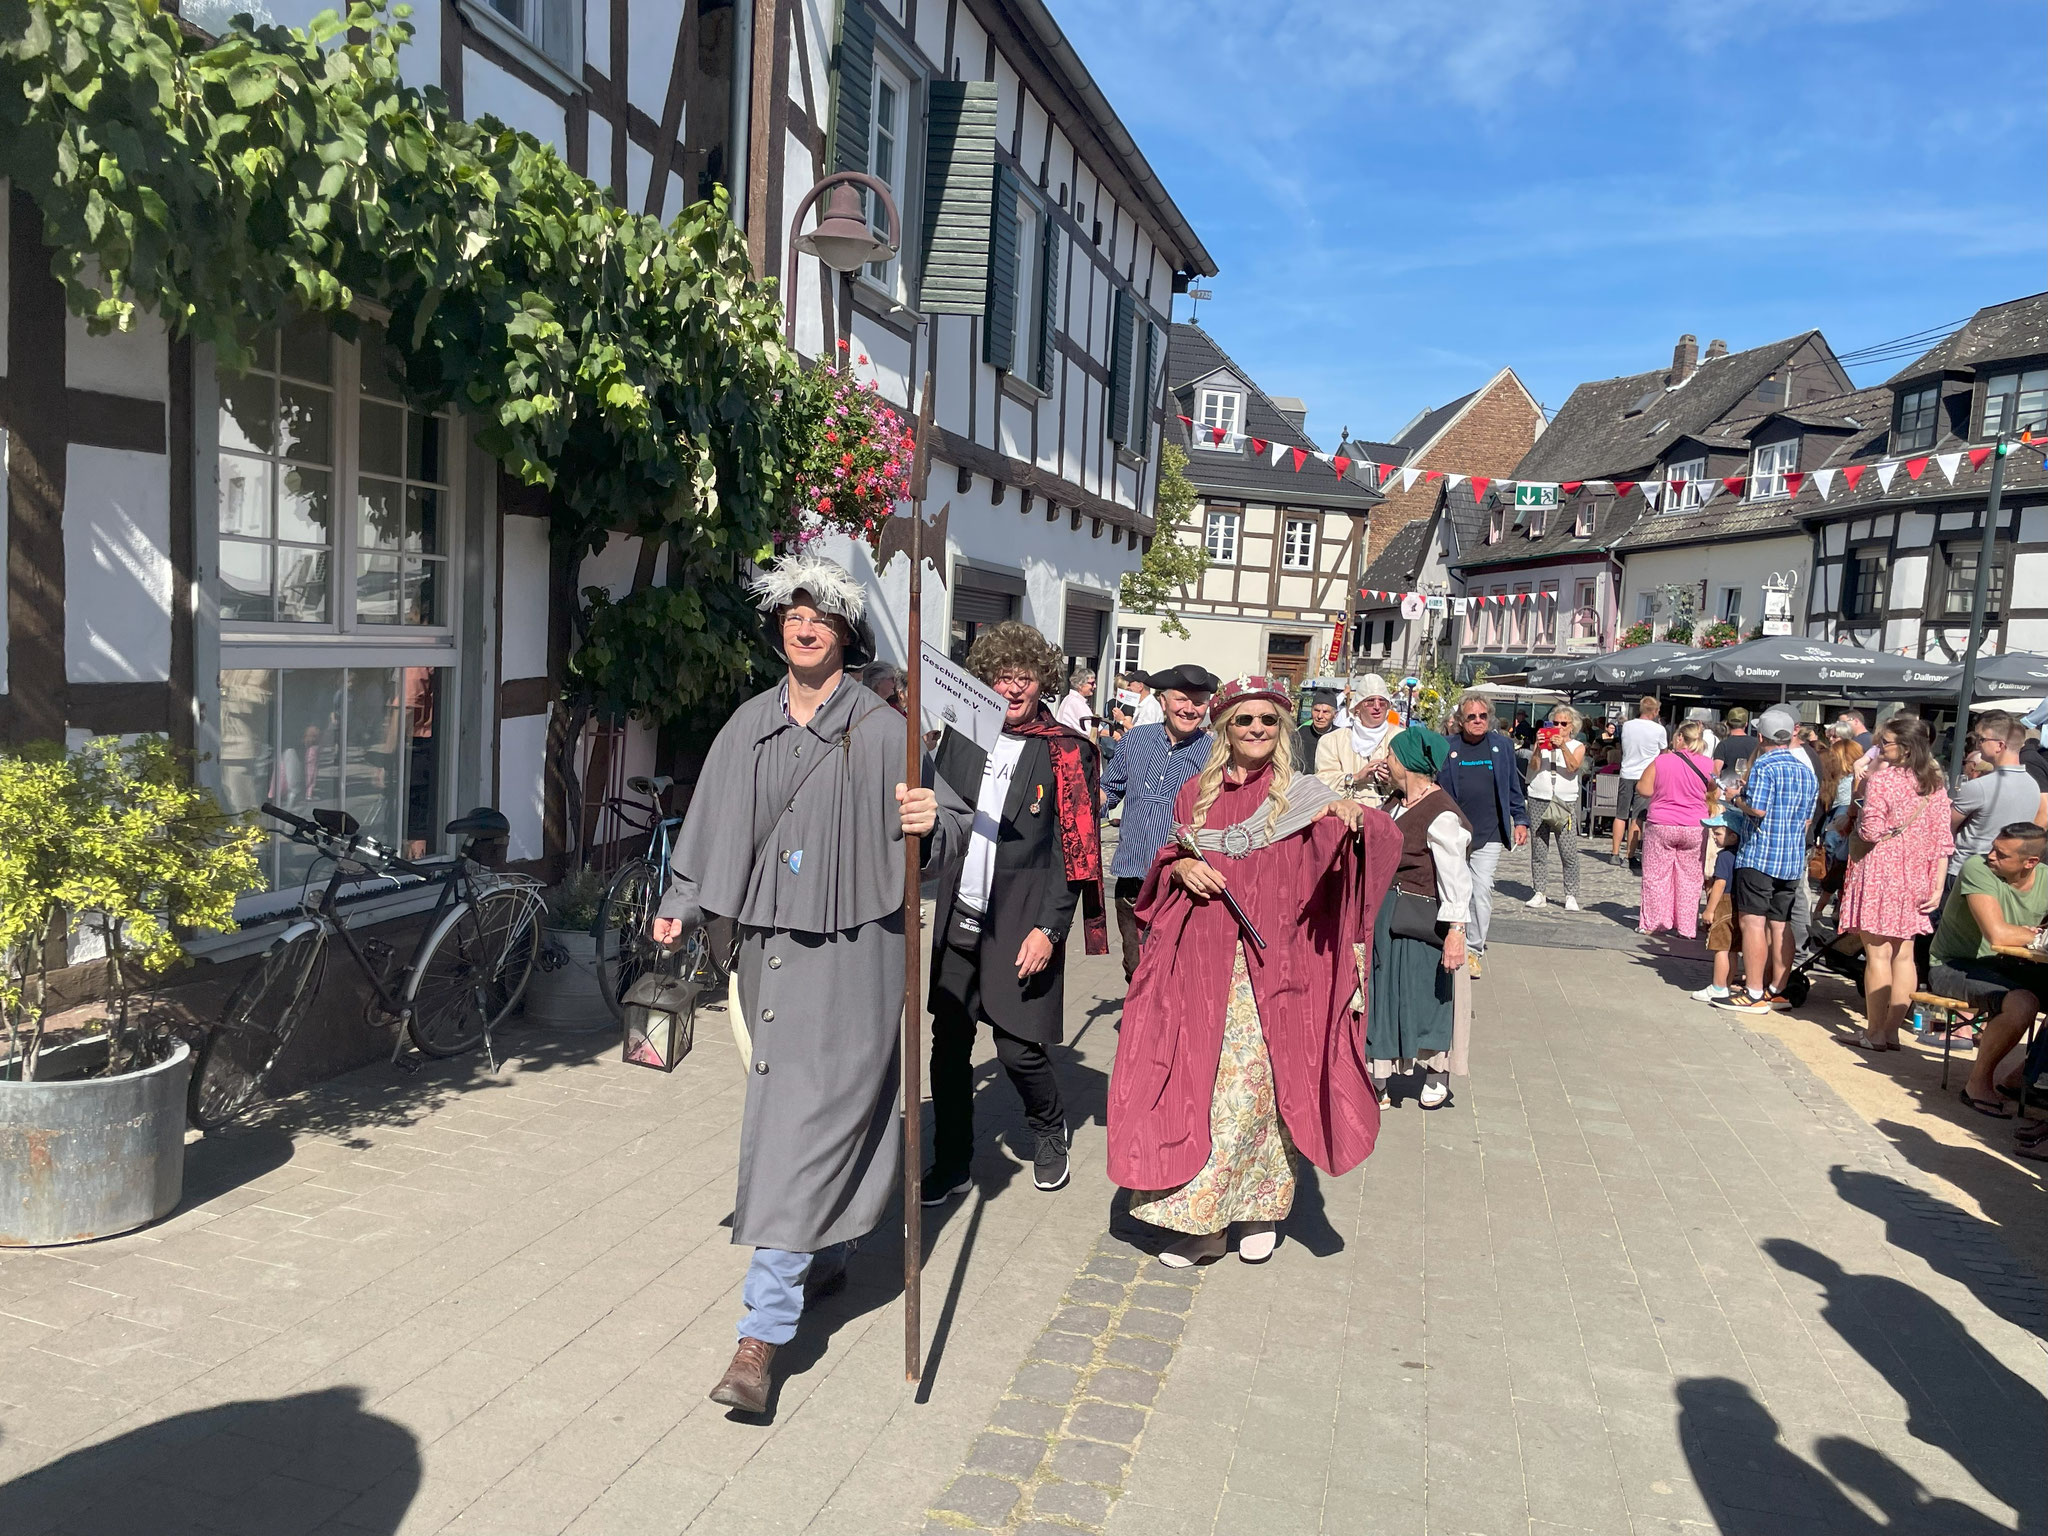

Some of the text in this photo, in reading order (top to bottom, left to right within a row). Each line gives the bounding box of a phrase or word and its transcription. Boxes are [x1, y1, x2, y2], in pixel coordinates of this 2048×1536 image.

[1745, 667, 1780, 678] Dallmayr
[1829, 669, 1864, 680] Dallmayr
[1913, 672, 1949, 683] Dallmayr
[922, 654, 1001, 711] Geschichtsverein
[1998, 682, 2031, 691] Dallmayr
[934, 677, 981, 713] Unkel e.V.
